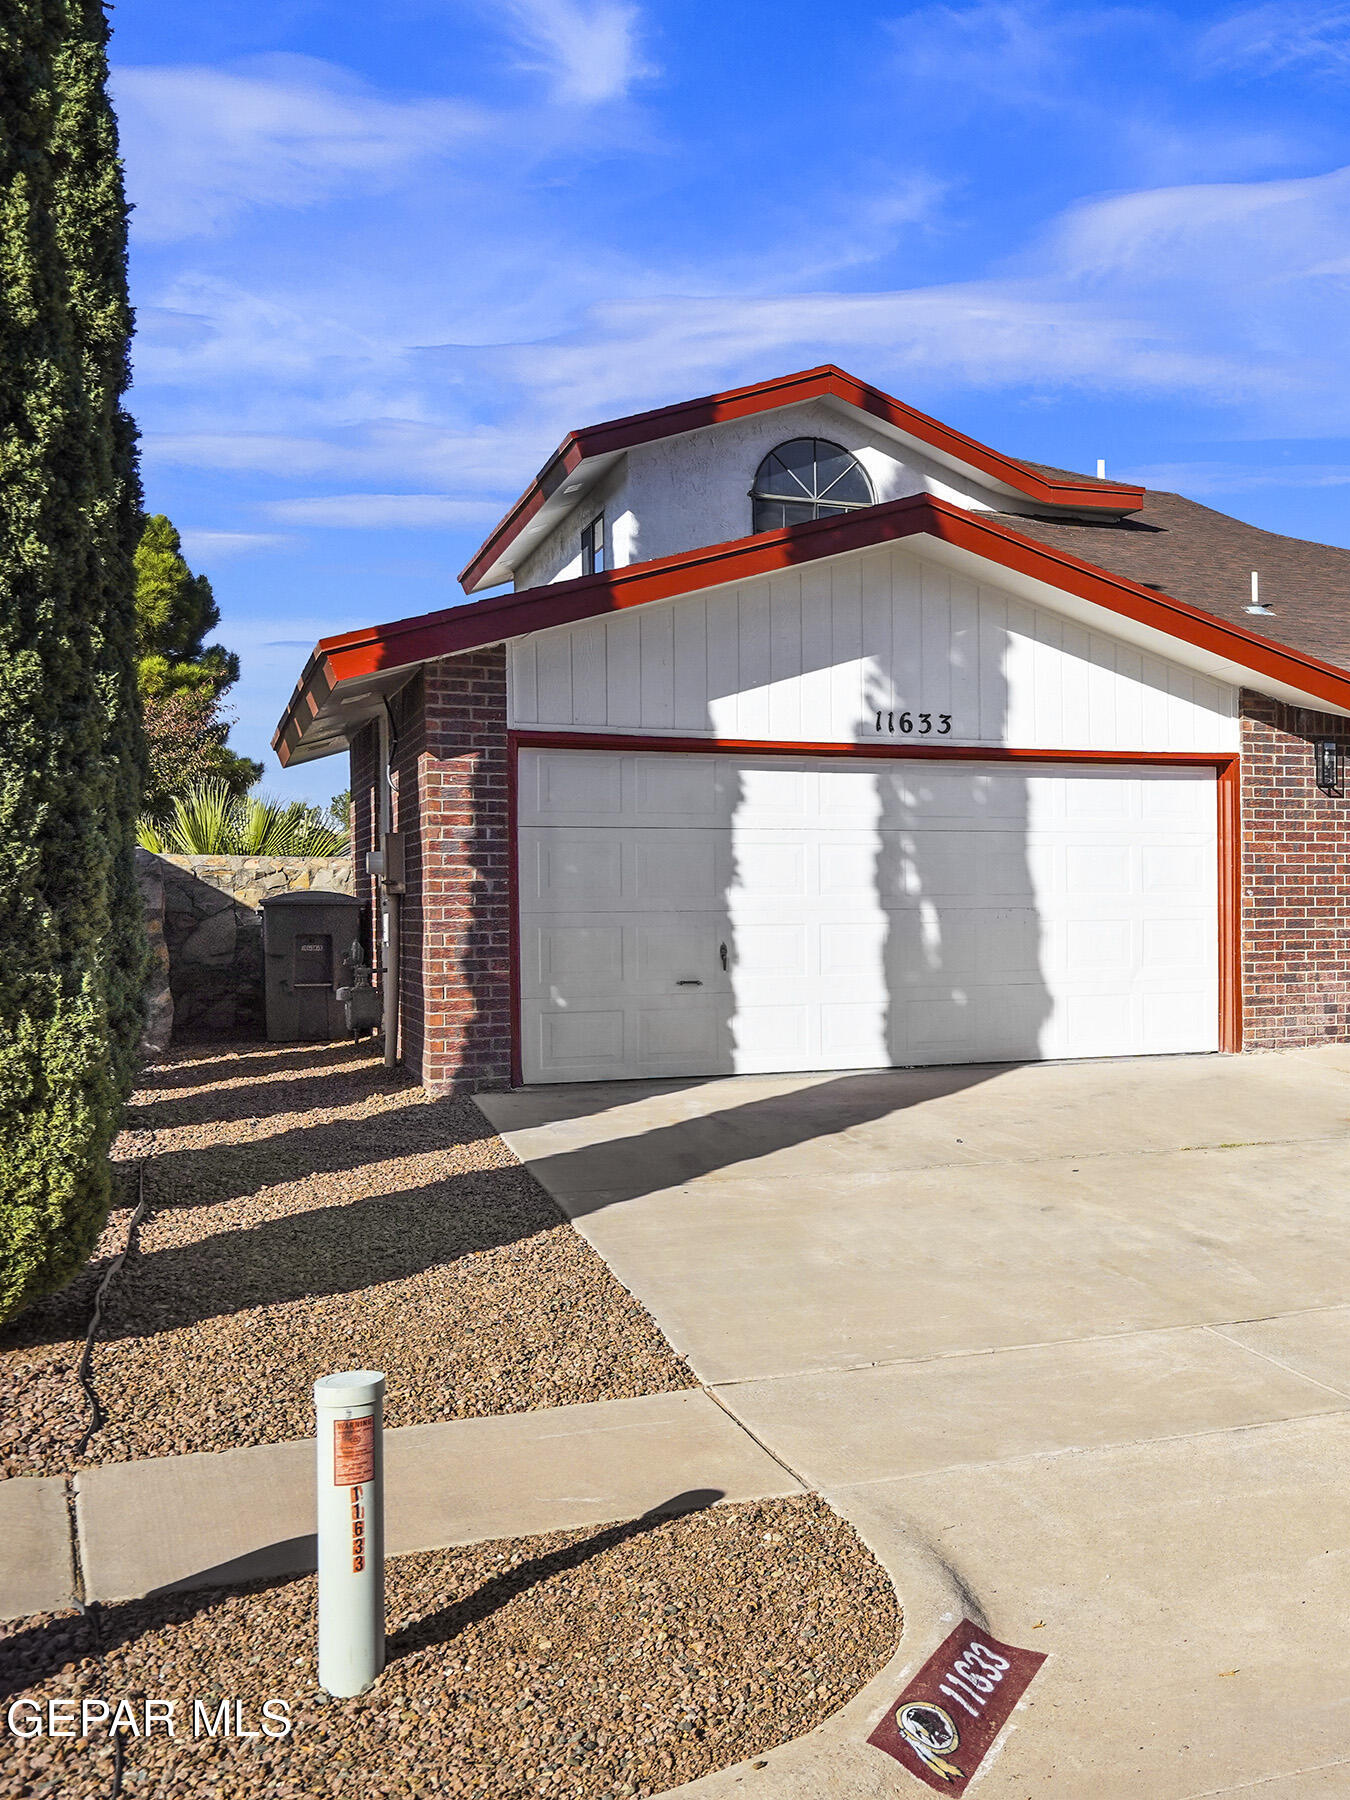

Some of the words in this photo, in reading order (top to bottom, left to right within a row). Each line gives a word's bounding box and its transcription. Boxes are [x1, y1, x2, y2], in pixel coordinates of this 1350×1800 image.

[875, 710, 952, 735] 11633
[337, 1418, 373, 1430] WARNING
[352, 1485, 364, 1572] 11633
[938, 1641, 1010, 1718] 11633
